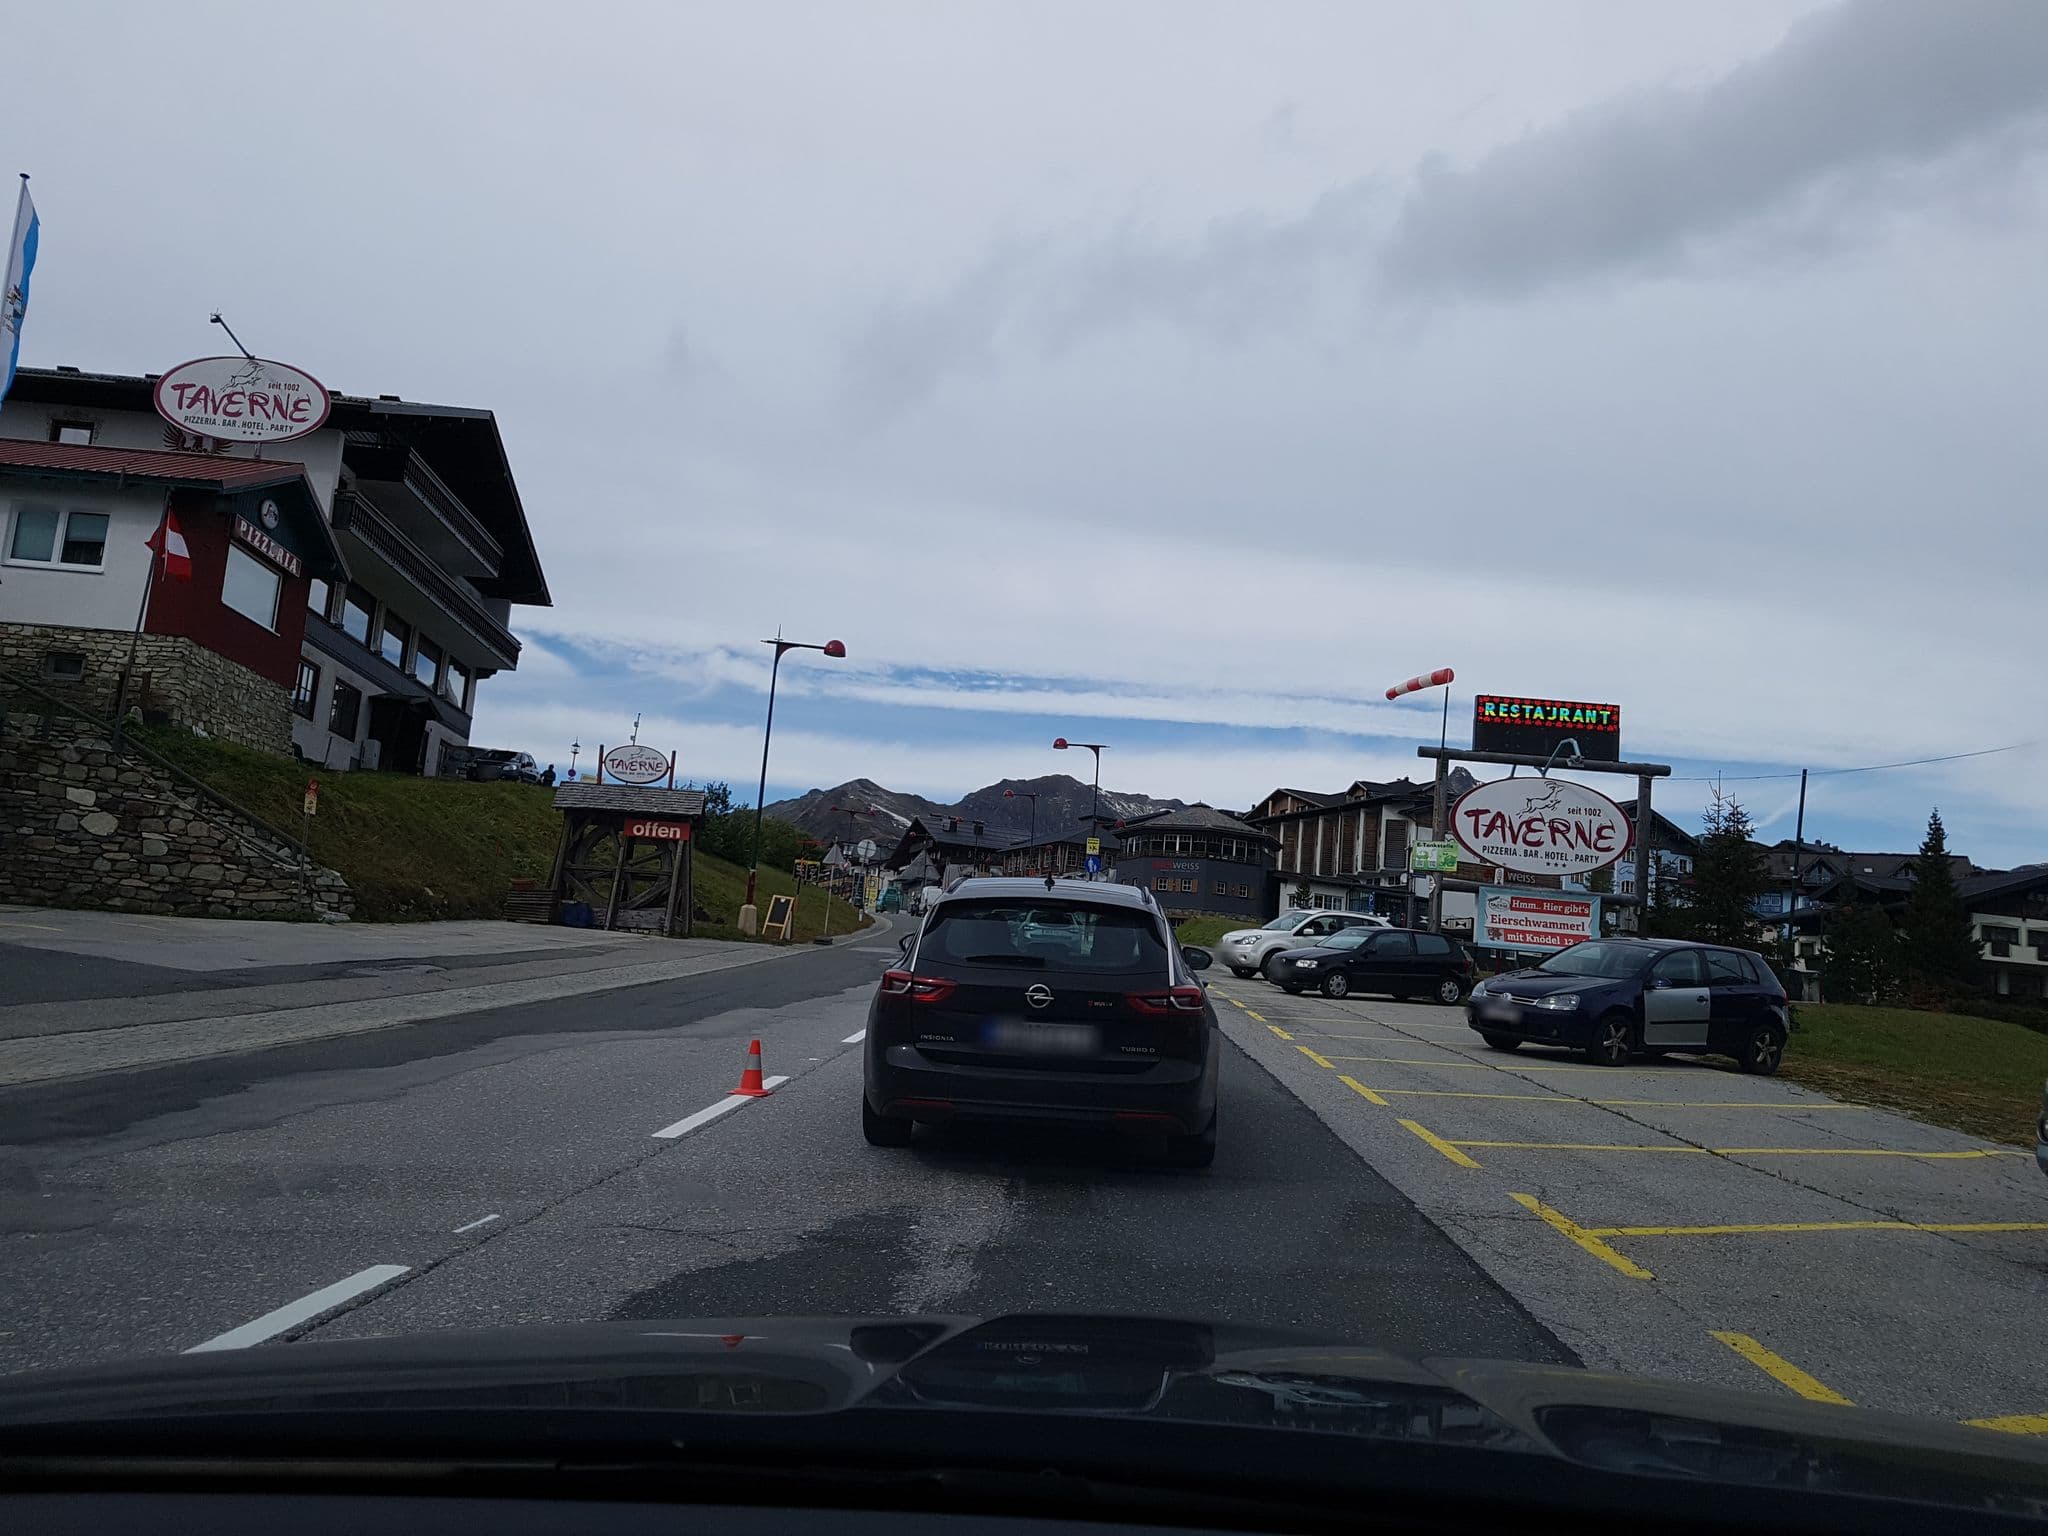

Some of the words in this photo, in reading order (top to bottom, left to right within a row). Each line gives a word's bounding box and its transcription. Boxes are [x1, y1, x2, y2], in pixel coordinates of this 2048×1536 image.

[268, 381, 281, 390] seit
[284, 382, 300, 392] 1002
[170, 382, 312, 424] TAVERNE
[184, 415, 217, 426] PIZZERIA
[222, 419, 237, 428] BAR
[242, 420, 264, 431] HOTEL
[270, 423, 294, 433] PARTY
[608, 758, 664, 773] TAVERNE
[1567, 806, 1582, 815] seit
[1584, 807, 1601, 817] 1002
[632, 821, 681, 839] offen
[1463, 807, 1617, 853] TAVERNE
[1482, 845, 1518, 857] PIZZERIA
[1523, 848, 1539, 859] BAR
[1544, 851, 1569, 862] HOTEL
[1574, 853, 1600, 865] PARTY
[1543, 902, 1562, 912] Hier
[1564, 904, 1590, 915] gibt's
[1490, 914, 1585, 931] Eierschwammerl
[1507, 932, 1524, 942] mit
[1526, 932, 1560, 945] Knödel
